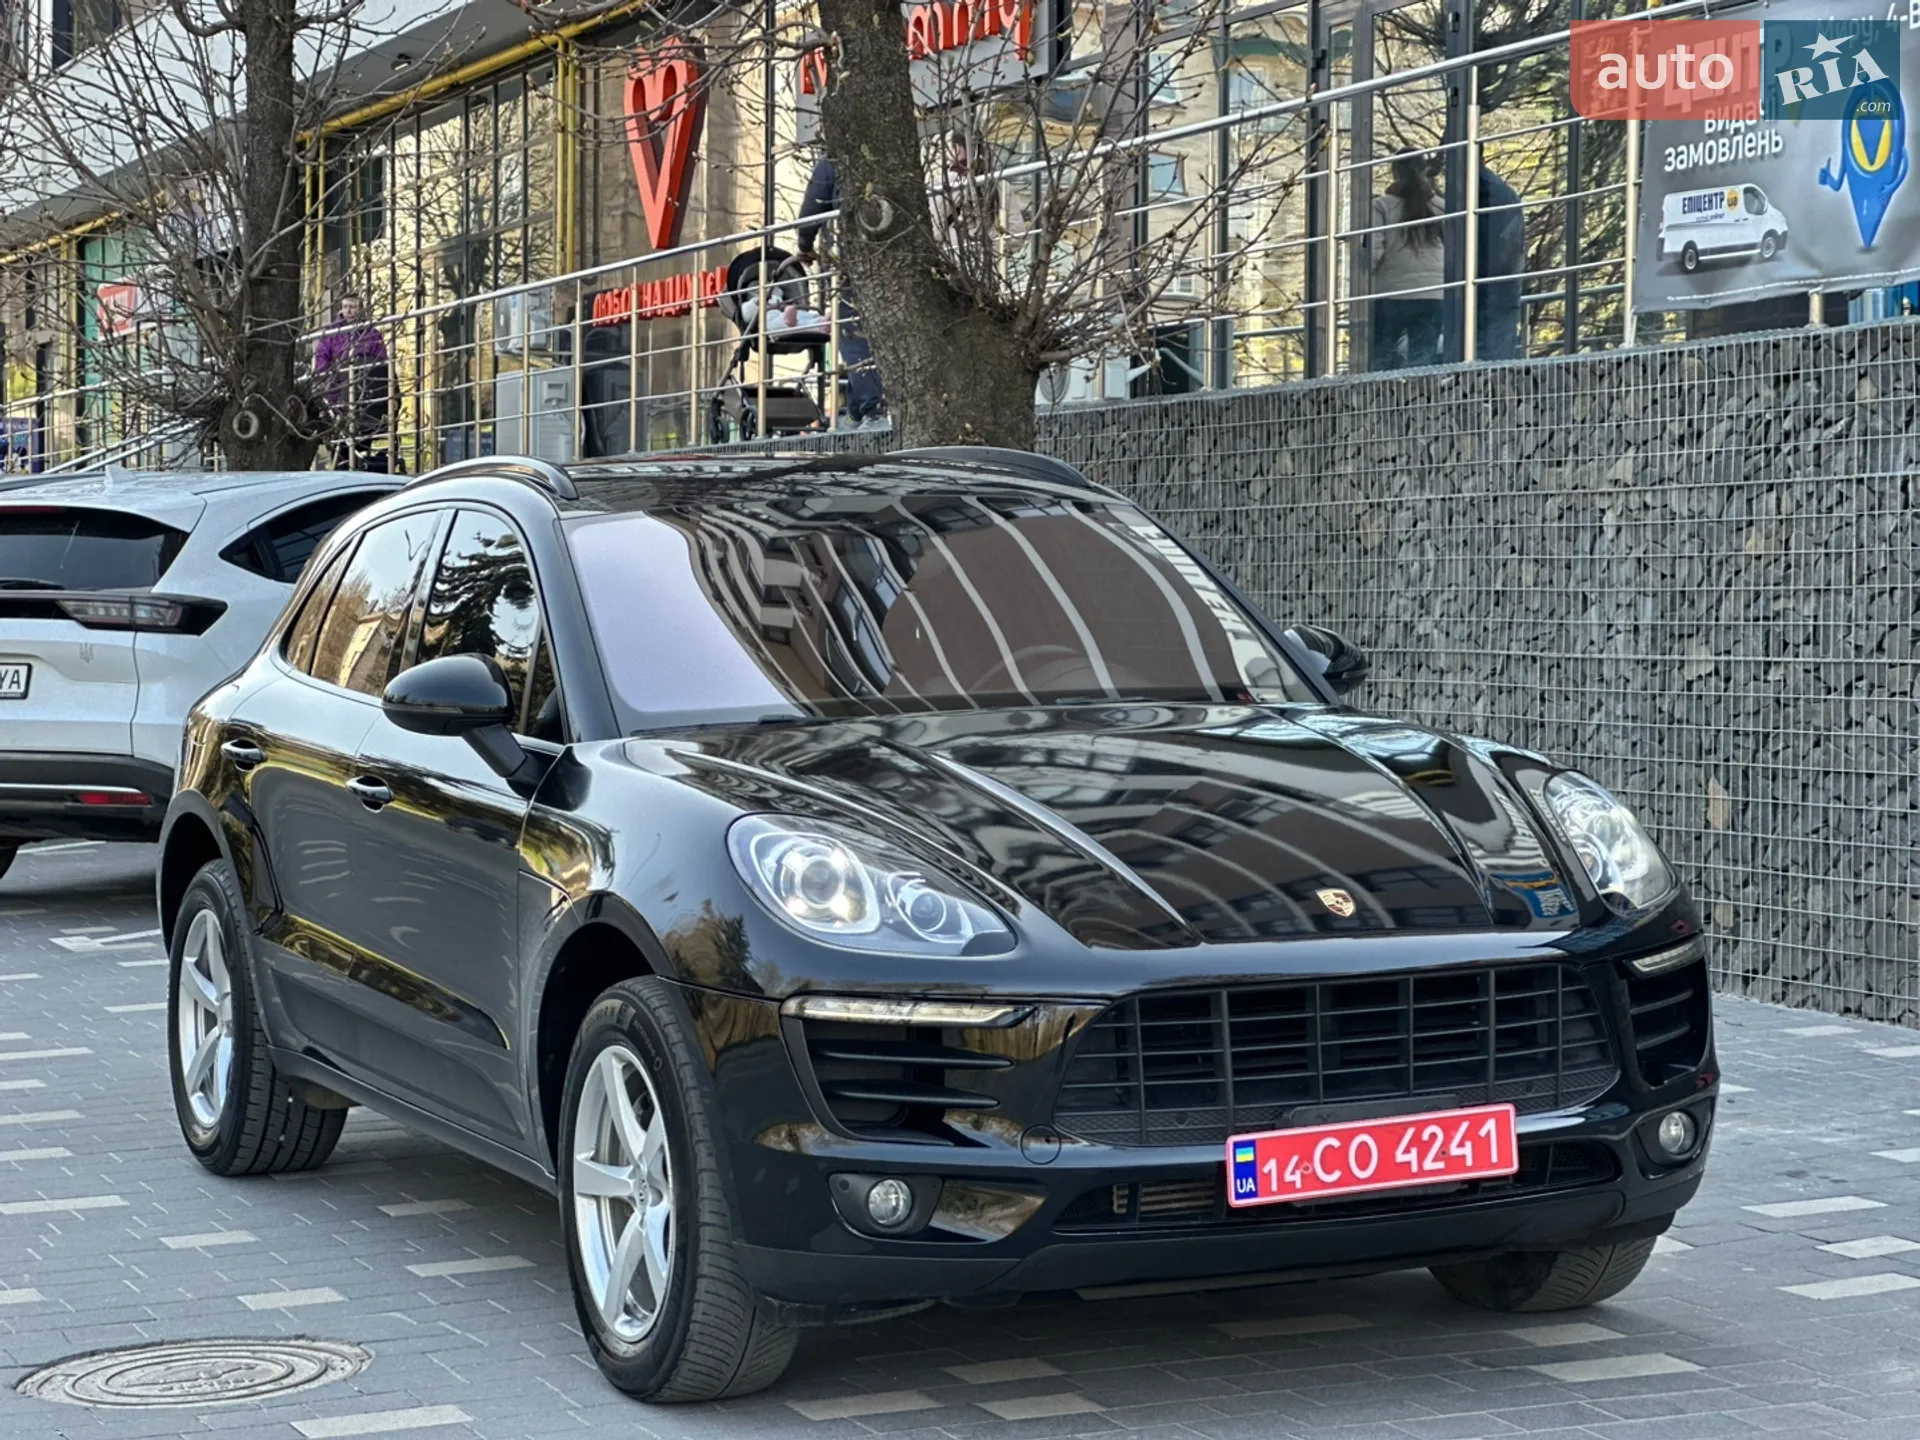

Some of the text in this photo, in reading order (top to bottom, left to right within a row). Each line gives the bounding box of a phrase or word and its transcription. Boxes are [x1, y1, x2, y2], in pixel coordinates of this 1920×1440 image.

[1663, 24, 1791, 113] ЦЕНТР
[1664, 128, 1784, 171] замовлень
[1683, 191, 1724, 214] ЕПІЦЕНТР
[1262, 1118, 1499, 1192] 14 CO 4241
[1236, 1177, 1256, 1193] UA
